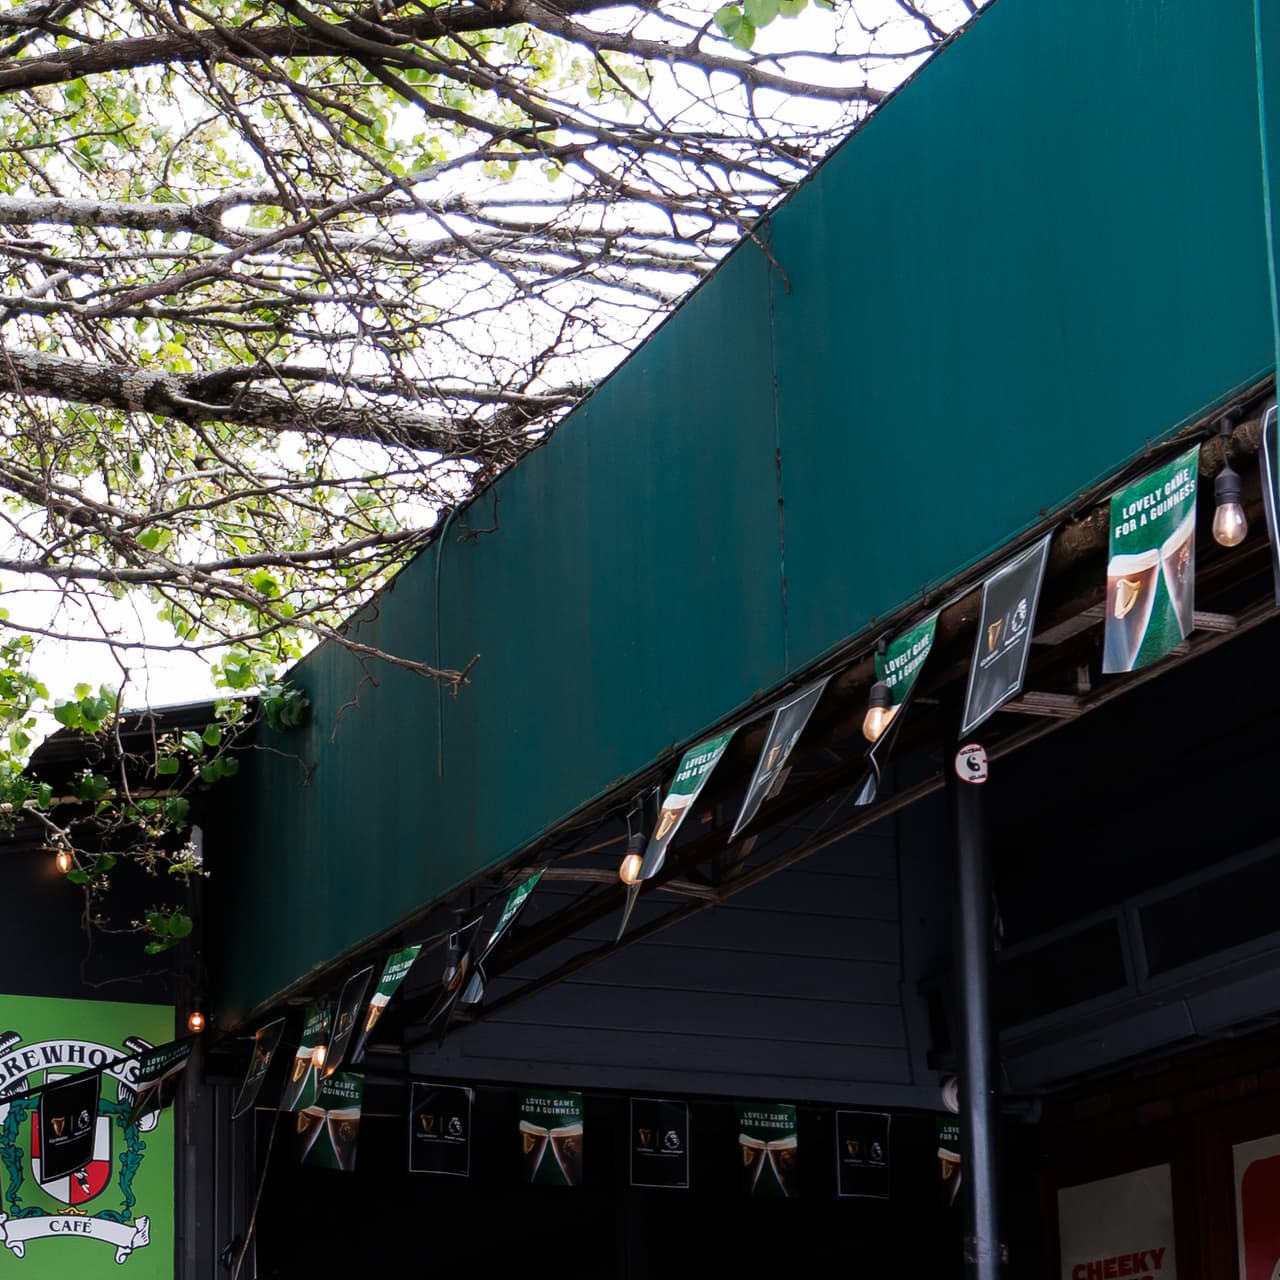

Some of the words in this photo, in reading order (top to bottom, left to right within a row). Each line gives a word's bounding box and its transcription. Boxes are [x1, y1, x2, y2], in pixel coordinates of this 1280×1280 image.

[1123, 491, 1161, 520] LOVELY
[1164, 468, 1189, 497] GAME
[1115, 522, 1136, 539] FOR
[1140, 513, 1147, 526] A
[1150, 480, 1196, 521] GUINNESS
[885, 651, 911, 674] LOVELY
[899, 670, 904, 680] A
[677, 770, 691, 782] FOR
[323, 1088, 360, 1099] GUINNESS
[525, 1098, 551, 1106] LOVELY
[553, 1099, 575, 1107] GAME
[543, 1107, 581, 1115] GUINNESS
[49, 1218, 93, 1234] CAFÉ
